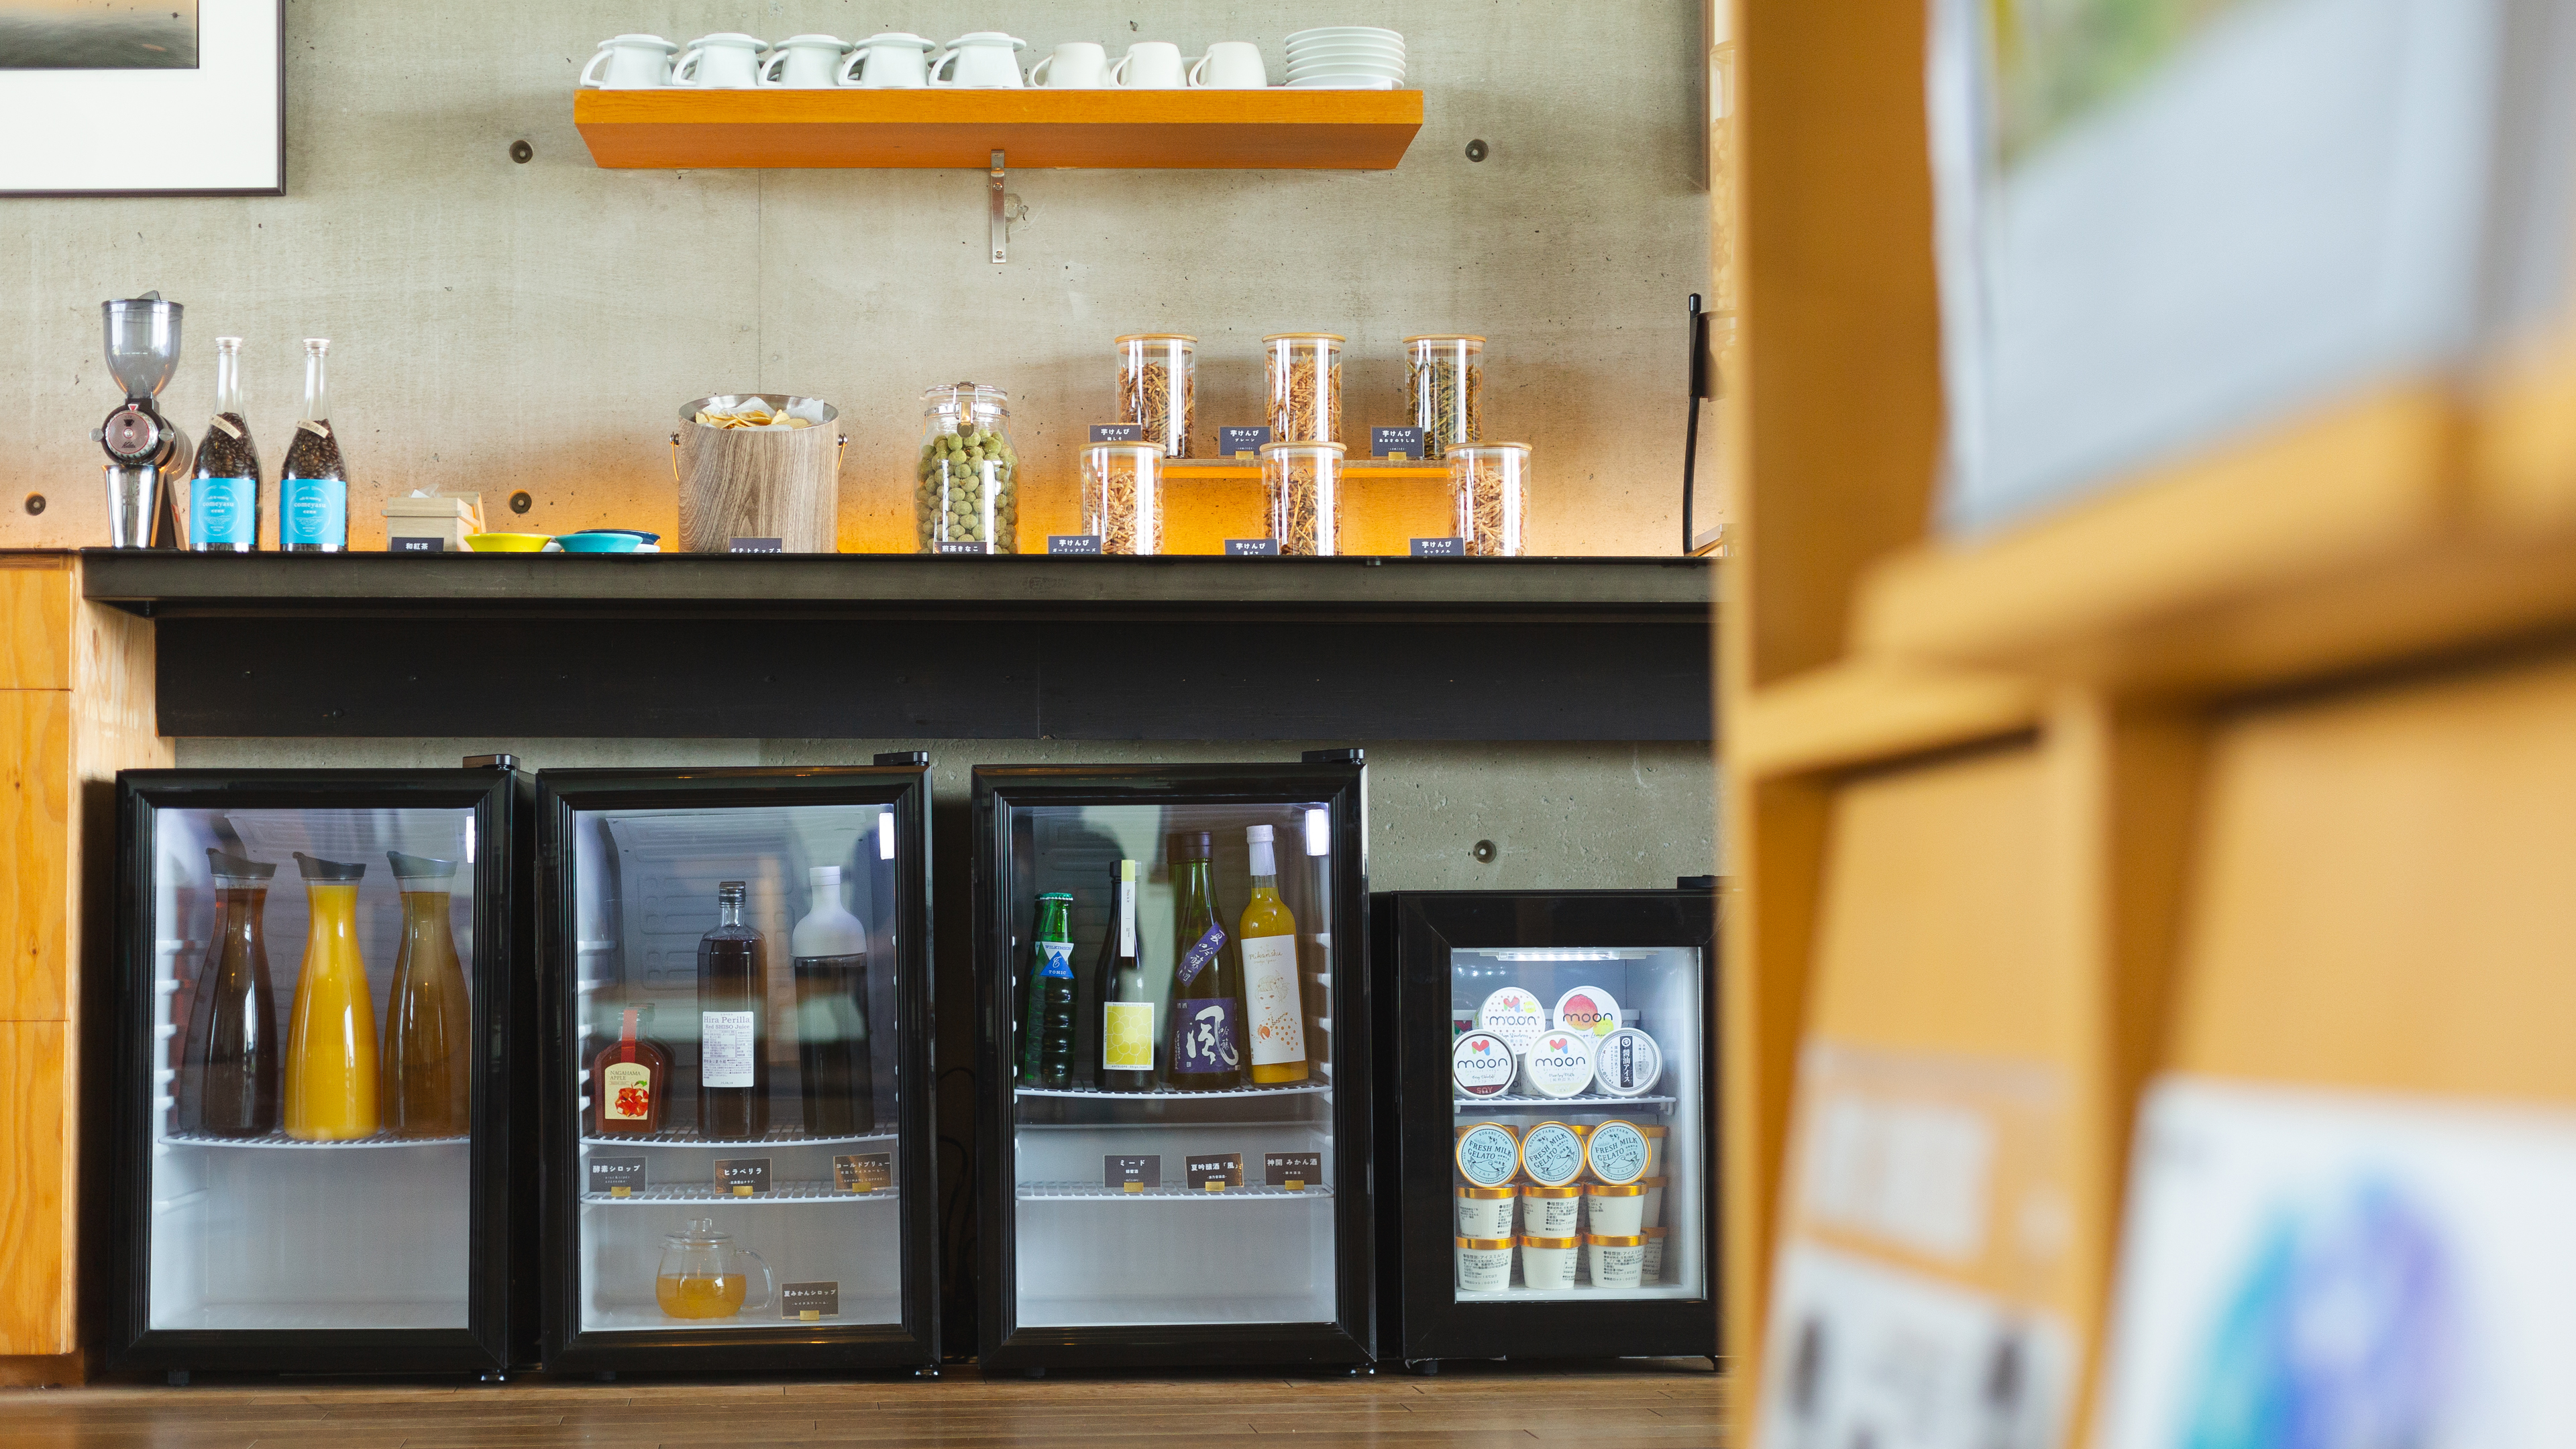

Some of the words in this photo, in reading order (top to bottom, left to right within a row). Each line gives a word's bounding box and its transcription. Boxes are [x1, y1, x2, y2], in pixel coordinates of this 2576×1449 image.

[1101, 428, 1130, 436] 芋けんぴ
[1059, 539, 1089, 547] 芋けんぴ
[1421, 541, 1452, 549] 芋けんぴ
[941, 545, 979, 553] 煎茶きなこ
[1489, 1016, 1537, 1026] moon
[1562, 1013, 1613, 1023] moon
[1457, 1058, 1508, 1069] moon
[1535, 1057, 1586, 1067] moon
[1477, 1086, 1493, 1094] SOY
[1599, 1128, 1615, 1140] KOKABU
[1497, 1134, 1509, 1145] FARM
[1528, 1132, 1542, 1148] KOKABU
[1468, 1140, 1493, 1152] FRESH
[1495, 1146, 1513, 1158] MILK
[1528, 1144, 1550, 1162] FRESH
[1549, 1132, 1568, 1146] MILK
[1595, 1142, 1618, 1154] FRESH
[1619, 1137, 1638, 1146] MILK
[1467, 1148, 1496, 1159] GELATO
[1534, 1147, 1558, 1169] GELATO
[1597, 1148, 1624, 1161] GELATO
[836, 1161, 890, 1169] コールドブリュー
[1267, 1159, 1283, 1167] 神開
[1286, 1158, 1318, 1166] みかん酒
[592, 1164, 641, 1173] 酵素シロップ
[724, 1167, 762, 1176] ヒラペリラ
[784, 1289, 837, 1297] 夏みかんシロップ
